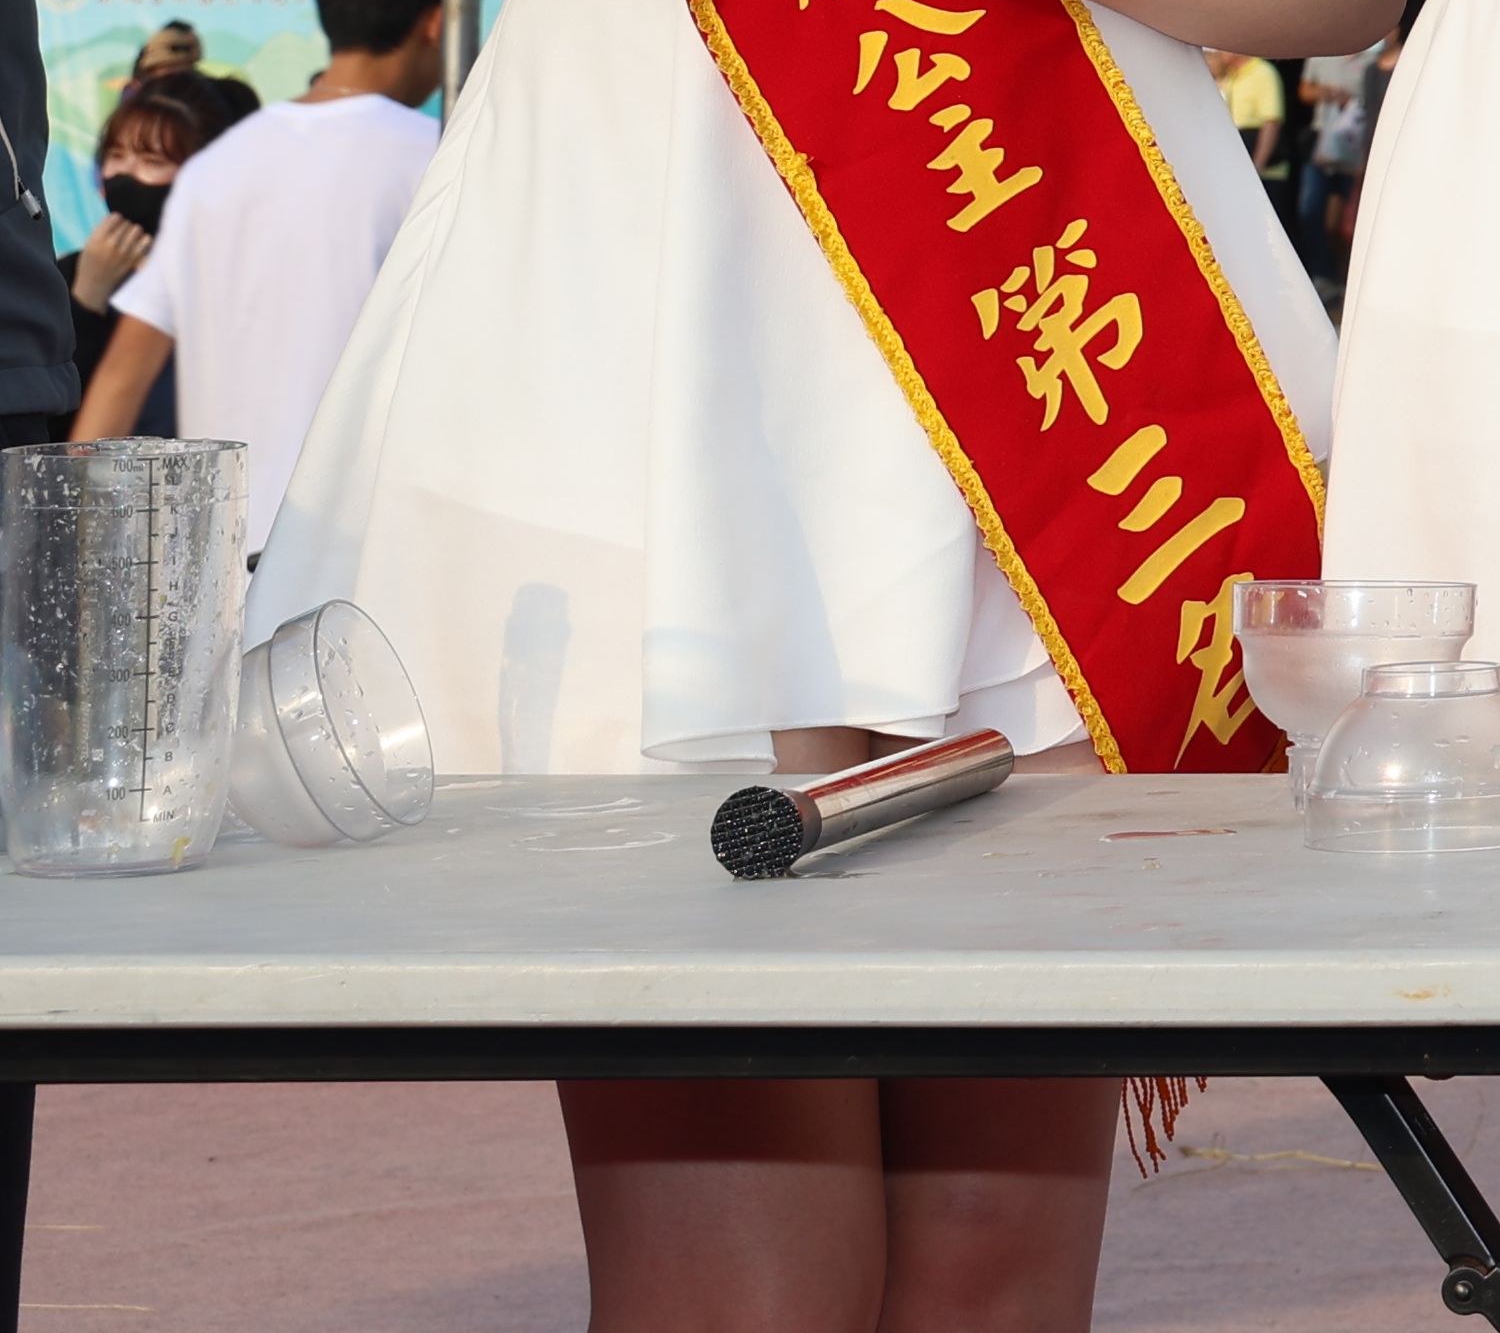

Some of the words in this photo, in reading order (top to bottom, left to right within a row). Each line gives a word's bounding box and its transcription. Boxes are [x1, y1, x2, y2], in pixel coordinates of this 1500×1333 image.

[162, 458, 187, 469] MAX
[112, 505, 133, 518] 600
[170, 505, 178, 514] K
[111, 557, 132, 570] 500
[169, 582, 178, 591] H
[168, 612, 177, 622] G
[109, 669, 129, 682] 300
[107, 726, 128, 739] 200
[166, 722, 174, 732] C
[165, 751, 173, 761] B
[106, 788, 125, 801] 100
[163, 785, 172, 794] A
[153, 810, 175, 822] MIN
